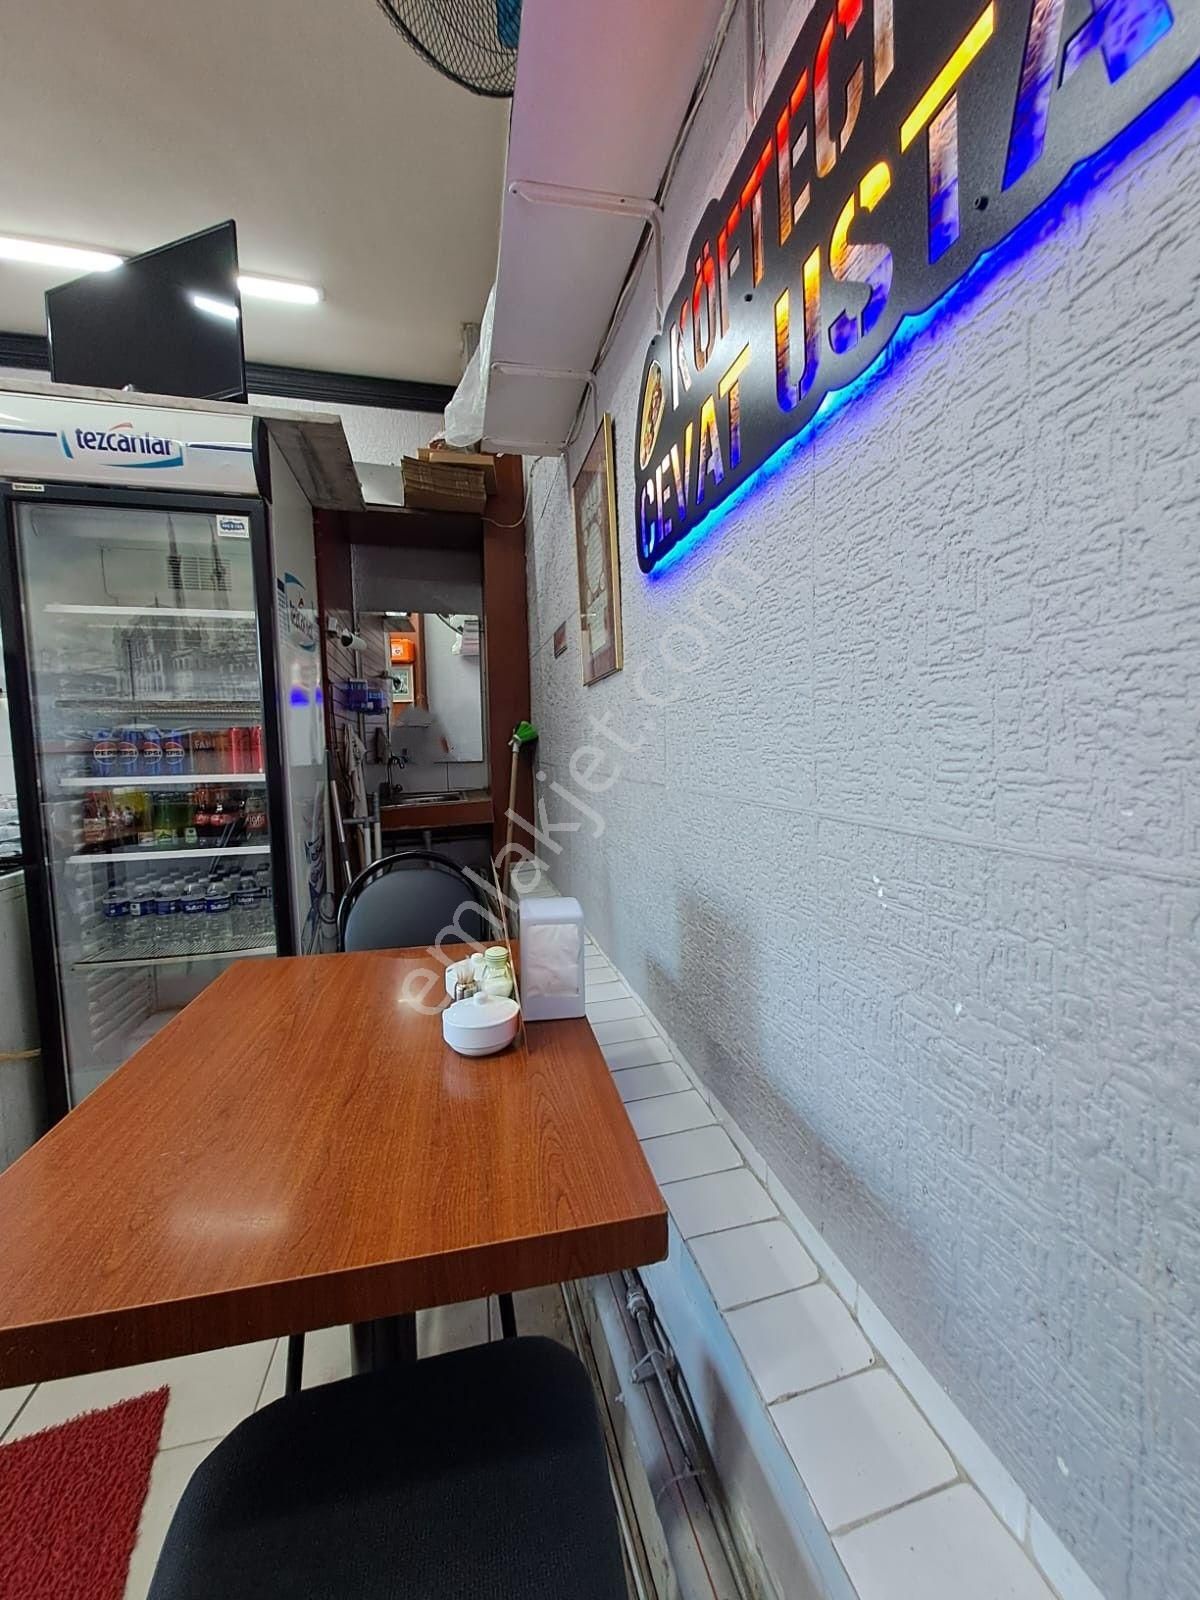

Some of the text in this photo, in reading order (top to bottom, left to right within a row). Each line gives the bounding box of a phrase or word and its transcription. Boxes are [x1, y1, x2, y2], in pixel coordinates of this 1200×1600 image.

[641, 0, 1175, 559] CEVAT USTA
[75, 428, 171, 456] tezcanlar
